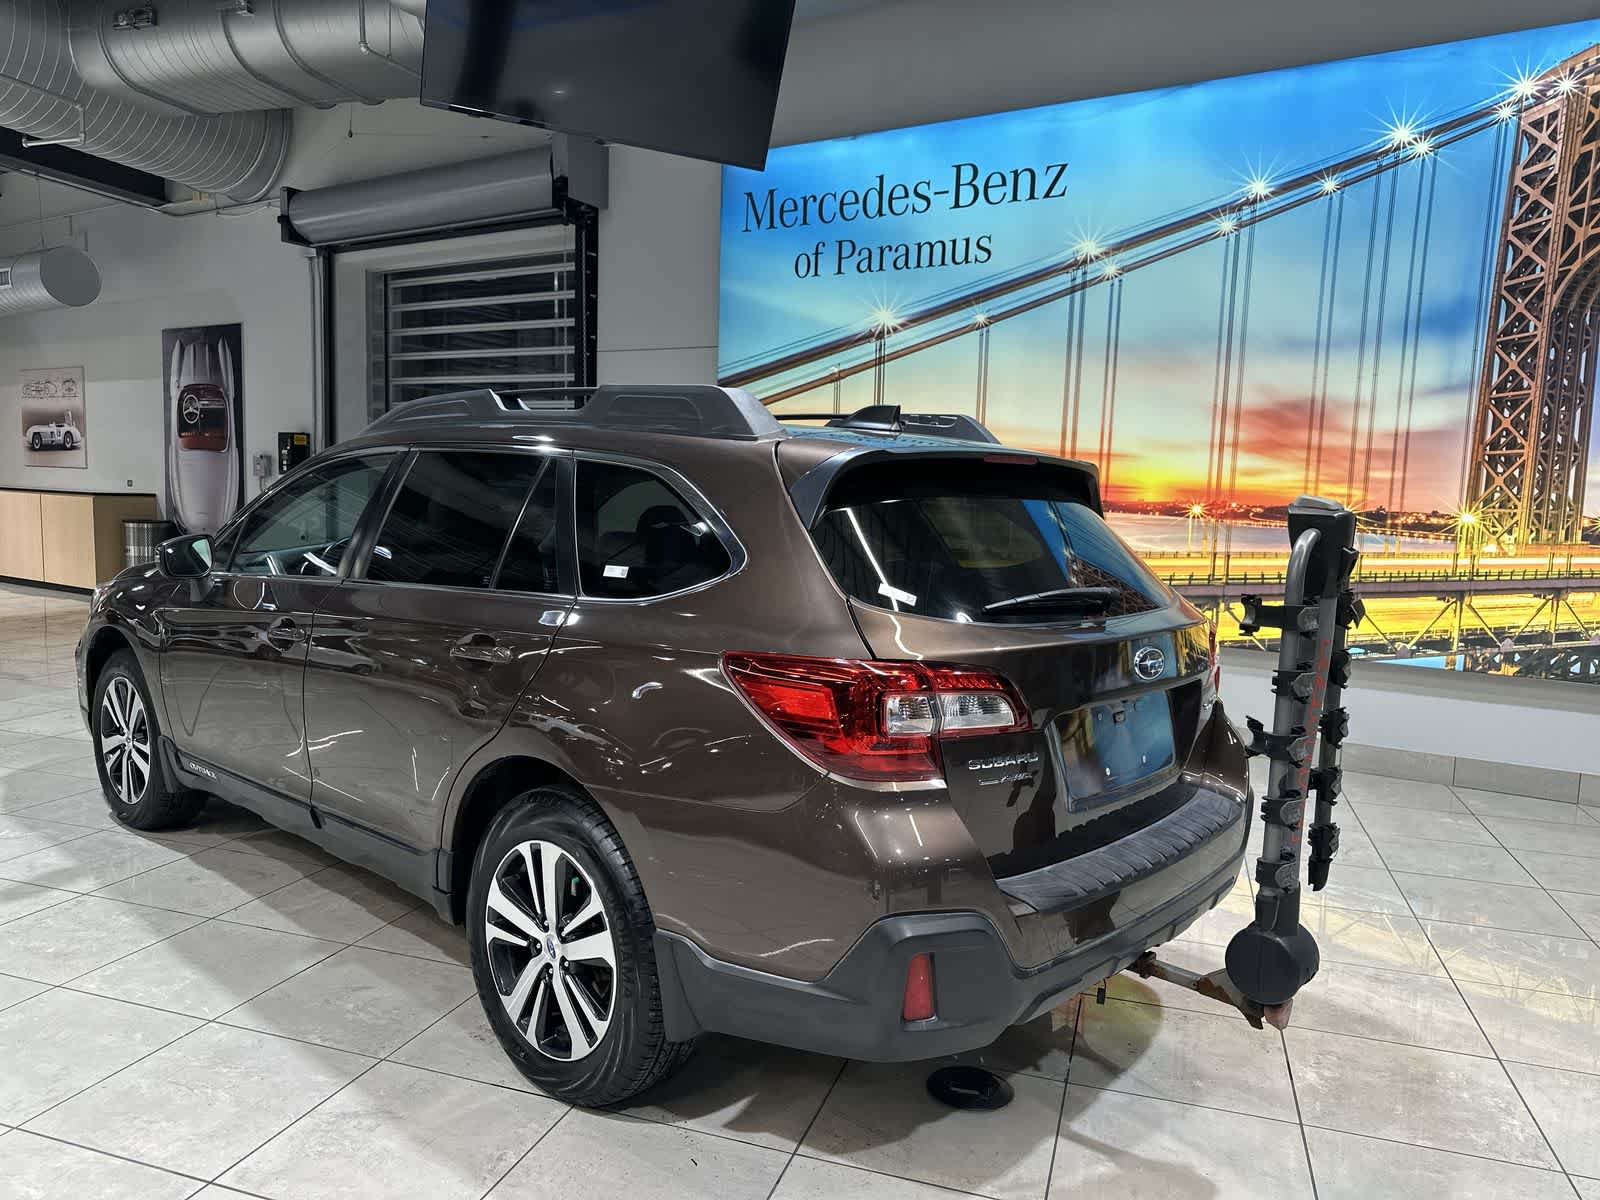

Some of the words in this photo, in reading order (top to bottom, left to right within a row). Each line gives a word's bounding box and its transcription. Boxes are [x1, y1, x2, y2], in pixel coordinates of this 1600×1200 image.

[742, 162, 1069, 233] Mercedes-Benz
[794, 241, 826, 279] of
[833, 233, 993, 276] Paramus
[968, 752, 1039, 770] SUBARU
